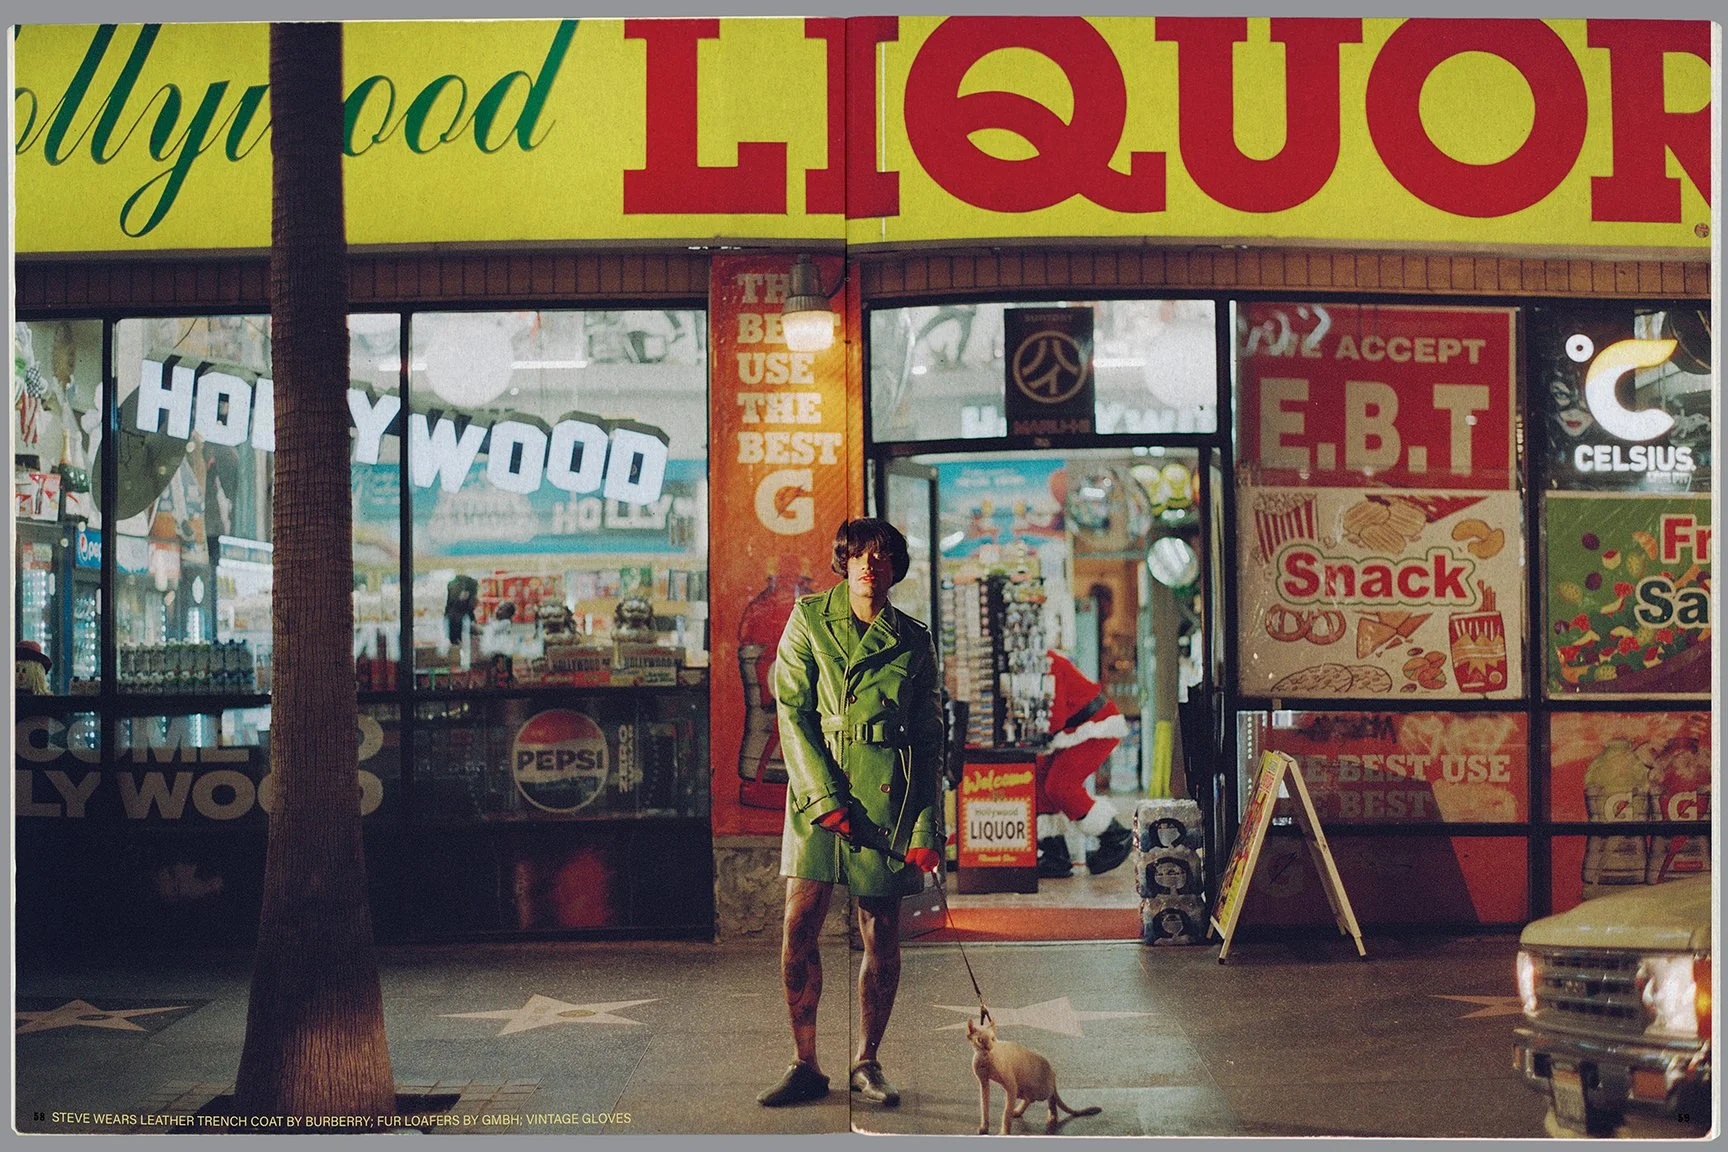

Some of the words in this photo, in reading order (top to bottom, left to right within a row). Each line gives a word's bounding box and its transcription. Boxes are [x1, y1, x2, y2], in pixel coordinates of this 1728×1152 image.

[623, 16, 1711, 223] LIQUOR
[736, 273, 791, 304] TH
[736, 313, 841, 344] BE
[1335, 335, 1487, 365] ACCEPT
[736, 352, 815, 385] USE
[736, 392, 822, 424] THE
[1259, 376, 1490, 477] E.B.T
[736, 432, 843, 465] BEST
[754, 468, 815, 536] G
[1284, 551, 1468, 599] Snack
[516, 748, 605, 771] PEPSI
[1339, 754, 1431, 783] BEST
[1441, 754, 1511, 783] USE
[970, 820, 1026, 842] LIQUOR
